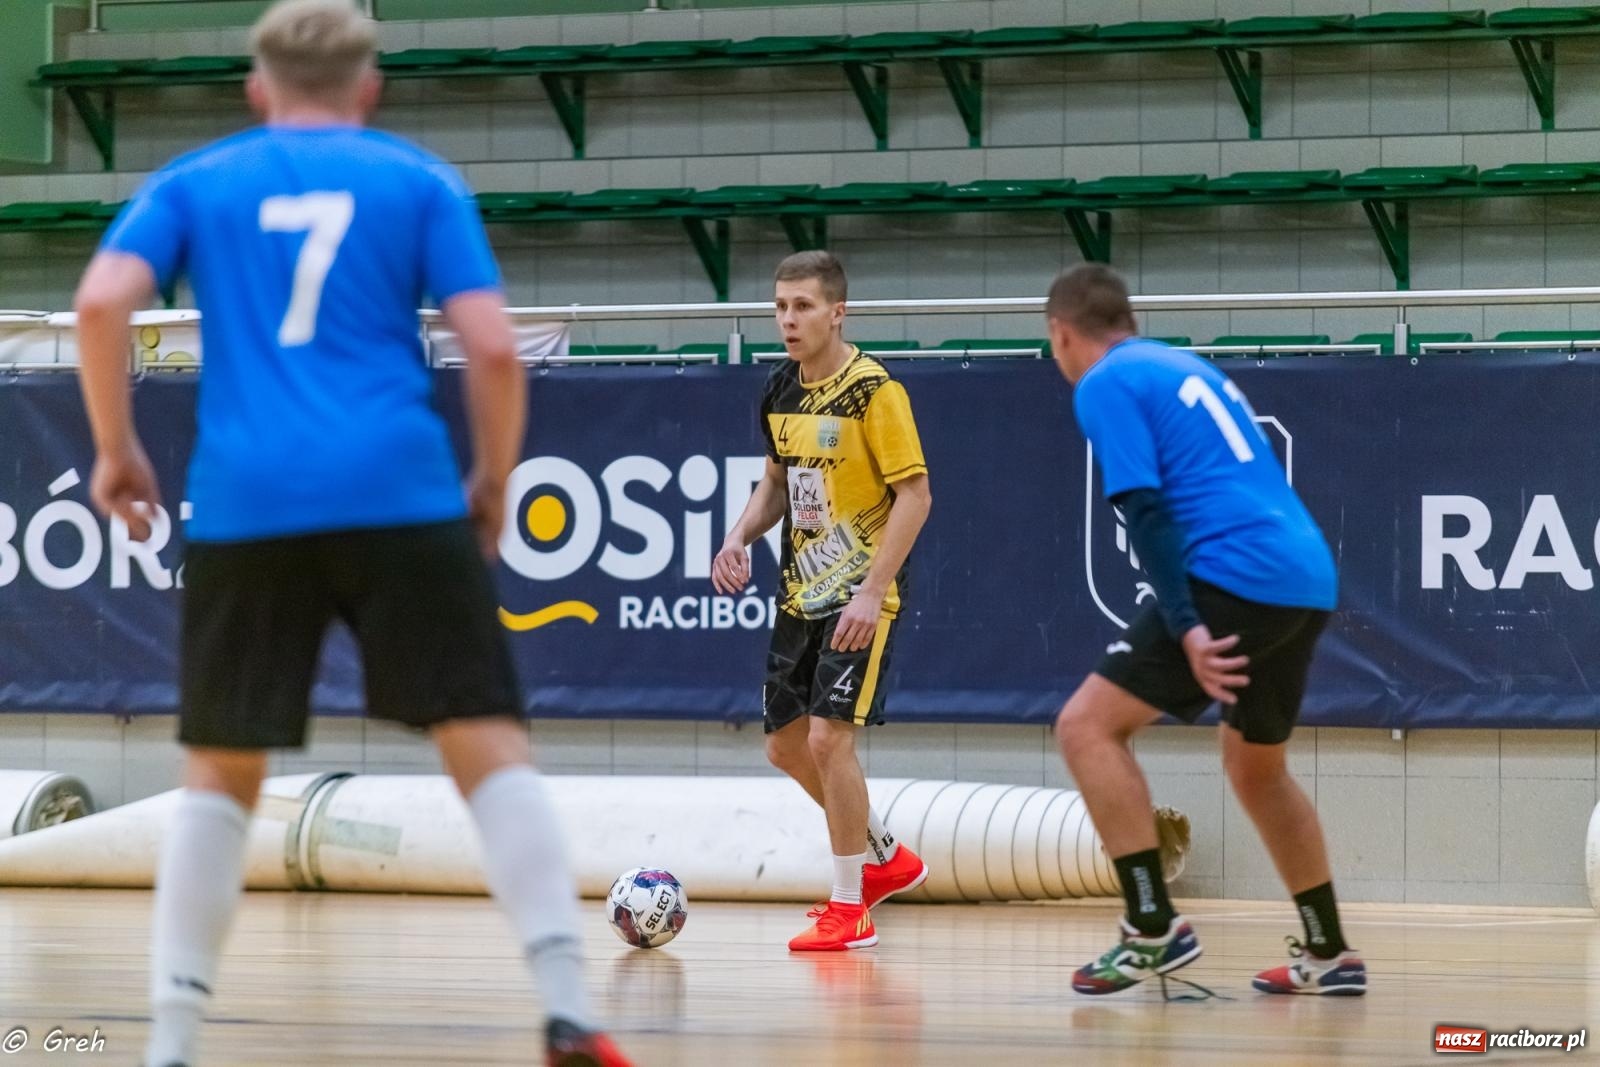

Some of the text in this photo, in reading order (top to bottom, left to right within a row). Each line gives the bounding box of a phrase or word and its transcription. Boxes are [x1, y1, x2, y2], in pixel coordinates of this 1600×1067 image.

[258, 189, 356, 347] 7
[778, 416, 789, 447] 4
[0, 467, 193, 590] ÓR
[1421, 494, 1600, 591] RA
[832, 665, 854, 695] 4
[645, 889, 672, 931] SELECT
